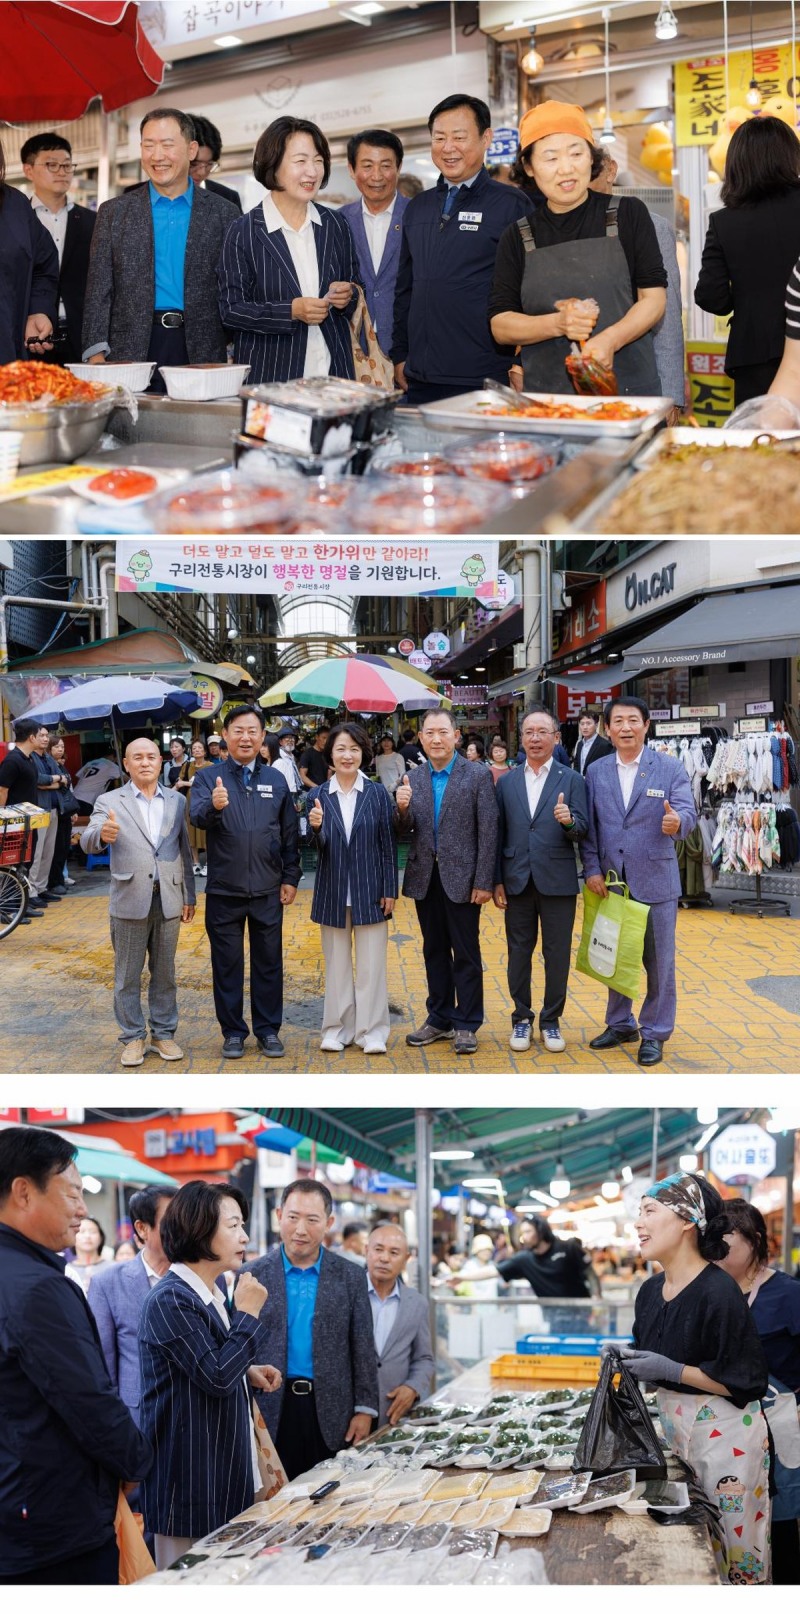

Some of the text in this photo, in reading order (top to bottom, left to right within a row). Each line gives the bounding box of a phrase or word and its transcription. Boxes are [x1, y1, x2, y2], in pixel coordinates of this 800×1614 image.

[183, 544, 429, 562] 더도 말고 덜도 말고 한가위만 같아라!
[169, 563, 441, 581] 구리전통시장이 행복한 명절을 기원합니다.
[296, 583, 330, 591] 구리전통시장
[641, 650, 727, 665] NO.1 Accessory Brand
